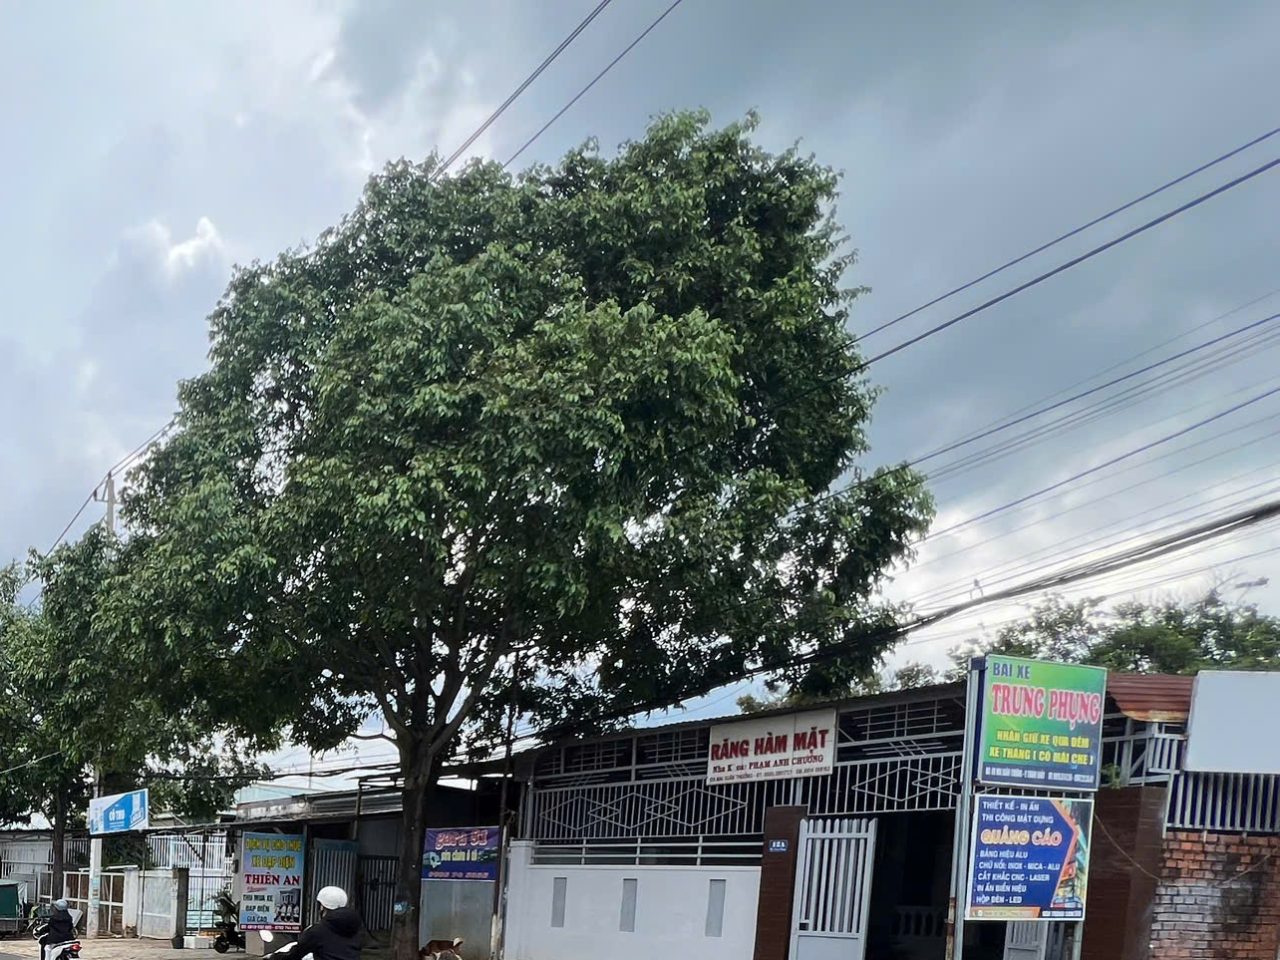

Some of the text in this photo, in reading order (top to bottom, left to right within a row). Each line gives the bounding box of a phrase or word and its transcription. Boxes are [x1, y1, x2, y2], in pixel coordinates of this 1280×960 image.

[1016, 665, 1030, 679] XE
[991, 683, 1101, 731] TRUNG PHỤNG
[711, 726, 829, 761] RĂNG HÀM MẶT
[1040, 734, 1050, 745] XE
[989, 746, 1000, 757] XE
[1002, 746, 1031, 760] THÁNG
[773, 758, 790, 768] ANH
[982, 800, 1003, 810] THIẾT
[1004, 800, 1015, 811] KẾ
[995, 813, 1015, 822] CÔNG
[980, 824, 1063, 846] QUẢNG CÁO
[245, 872, 301, 886] THIÊN AN
